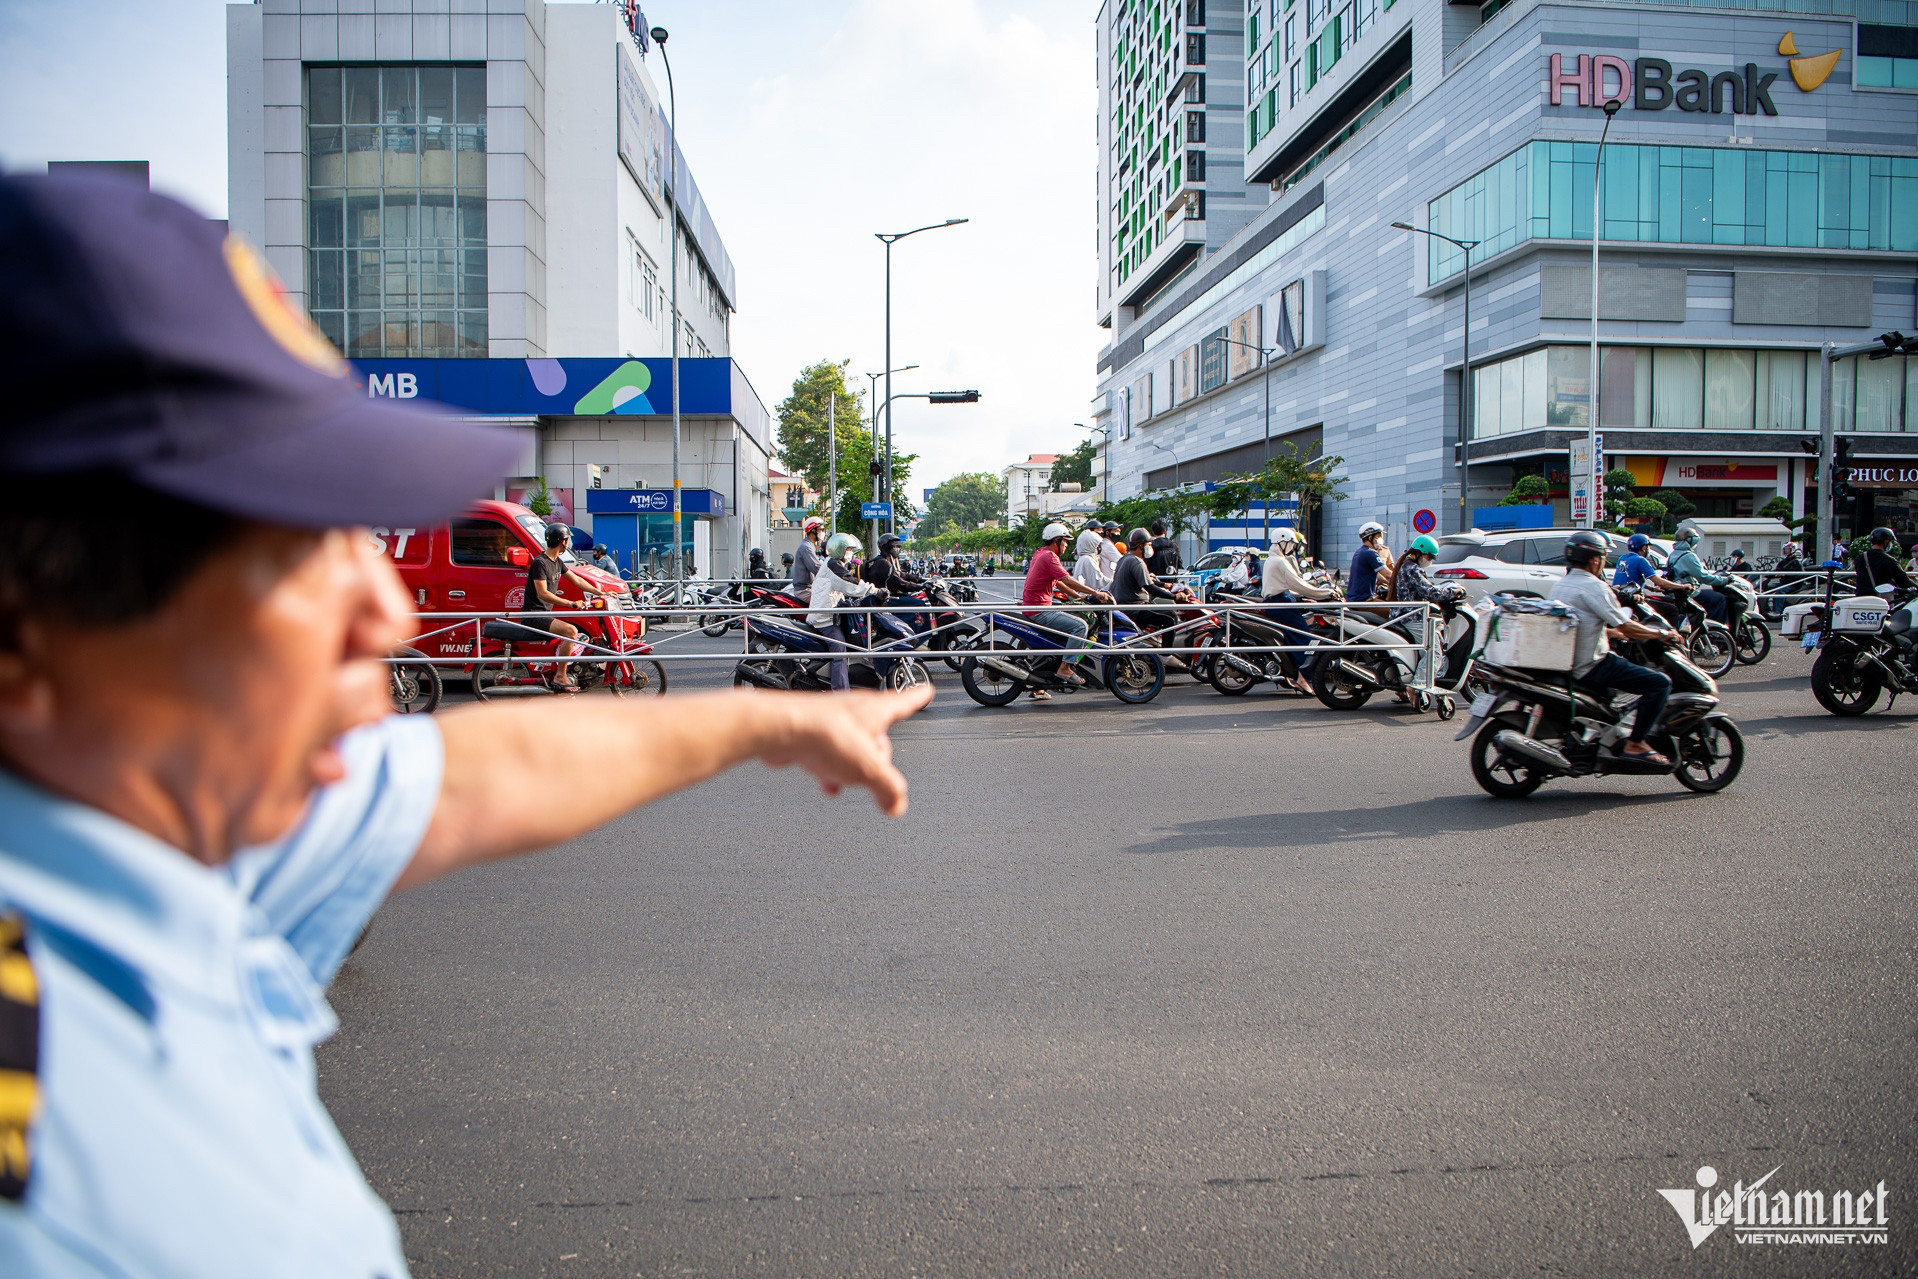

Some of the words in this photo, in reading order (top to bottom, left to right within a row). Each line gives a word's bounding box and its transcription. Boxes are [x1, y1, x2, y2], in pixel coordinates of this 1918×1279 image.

[1550, 53, 1779, 116] HDBank
[368, 373, 418, 399] MB
[1678, 466, 1727, 479] HDBank
[629, 495, 650, 504] ATM
